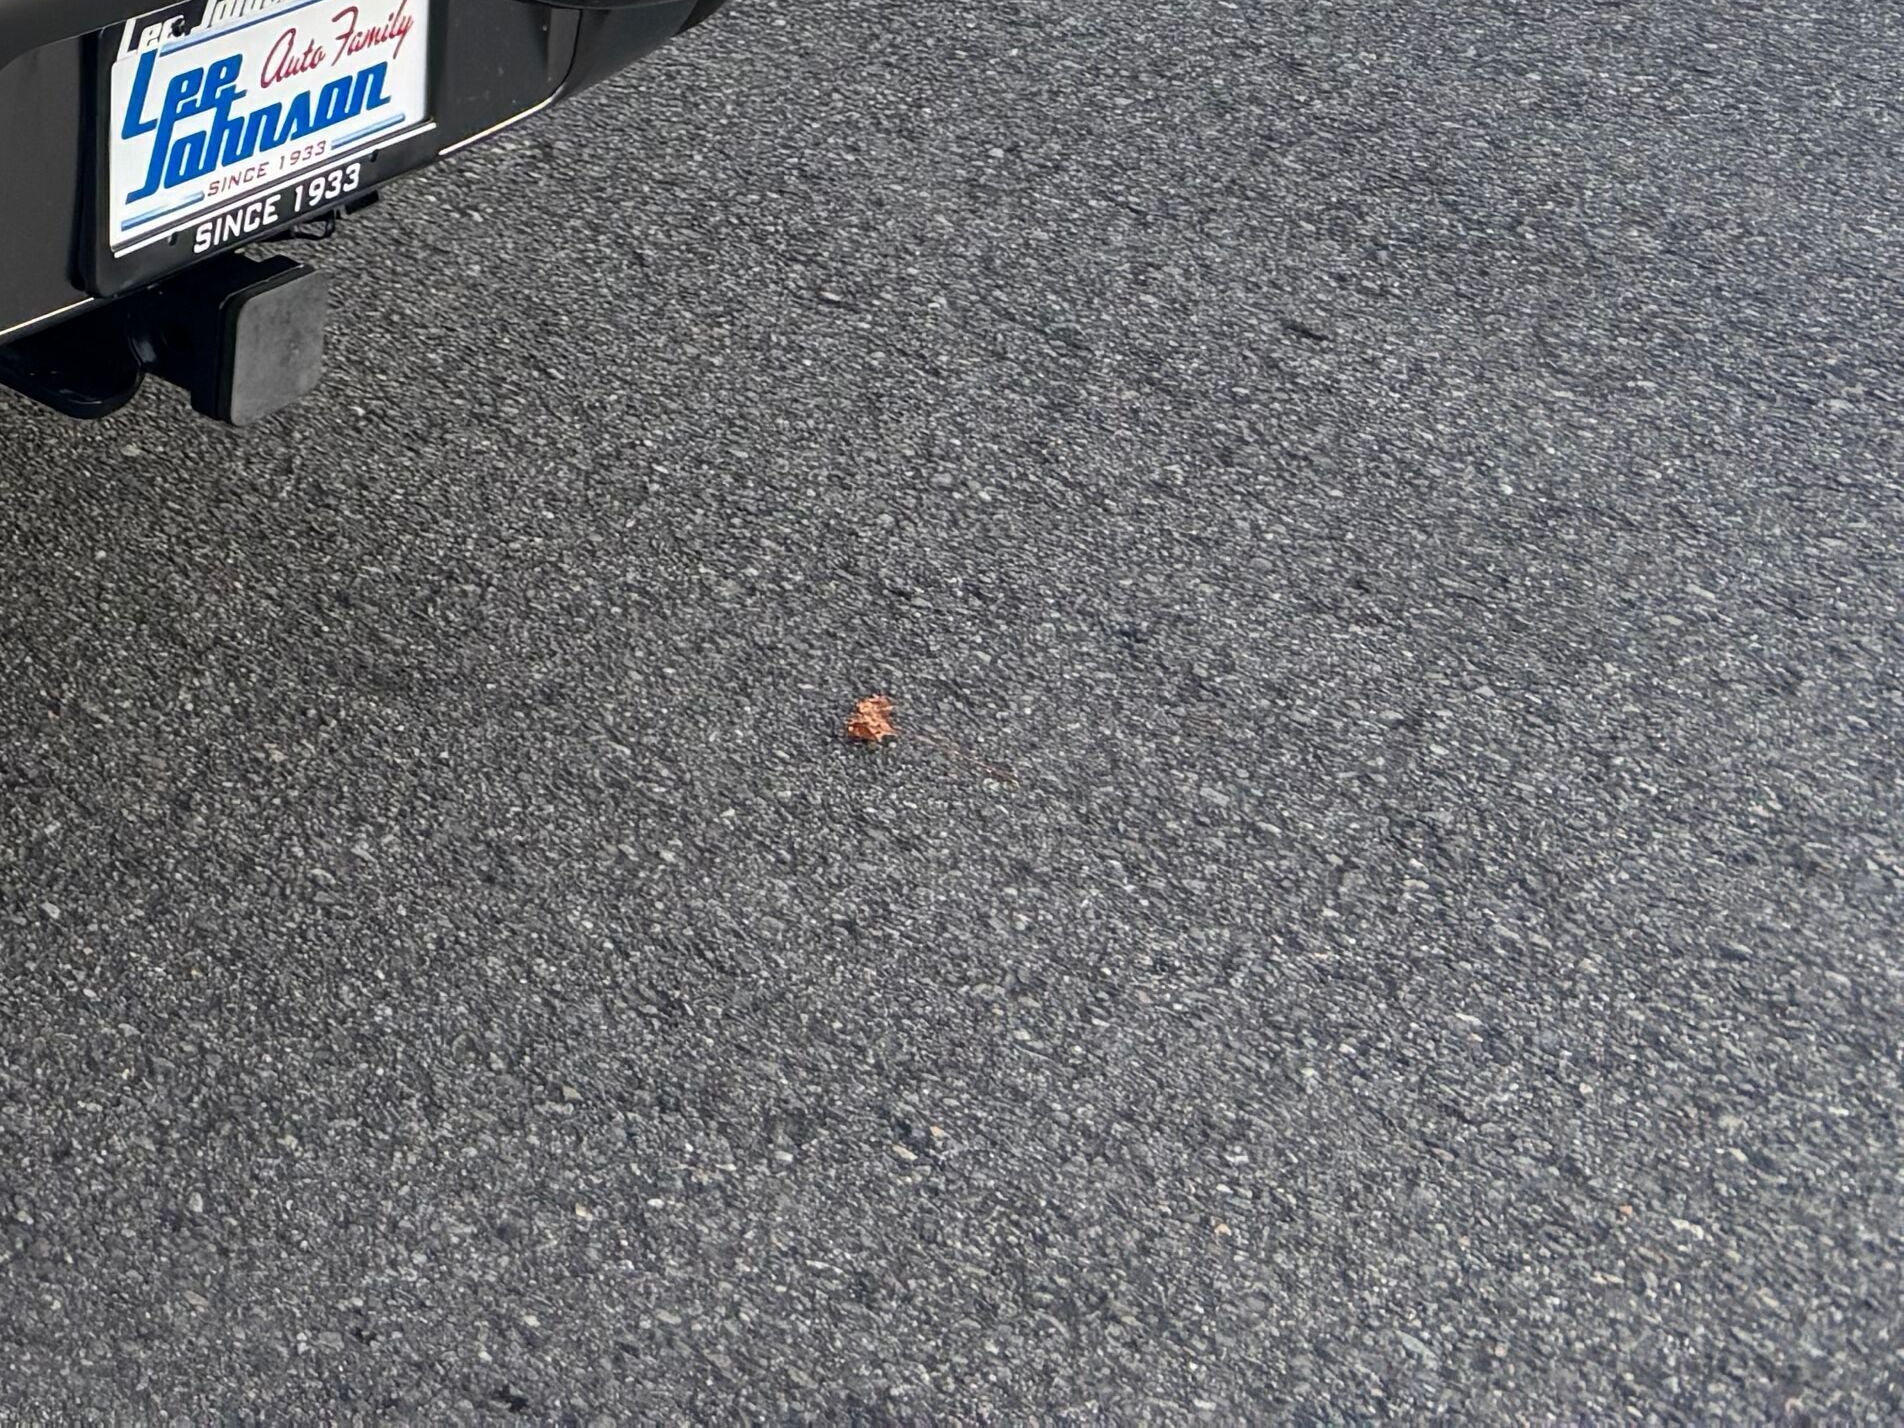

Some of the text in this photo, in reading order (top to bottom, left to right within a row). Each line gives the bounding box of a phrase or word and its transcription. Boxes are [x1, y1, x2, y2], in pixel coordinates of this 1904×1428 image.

[121, 48, 244, 140] Lee
[260, 27, 326, 89] Auto
[125, 61, 392, 205] Johnson
[207, 139, 327, 196] SINCE 1933
[193, 162, 361, 254] SINCE 1933
